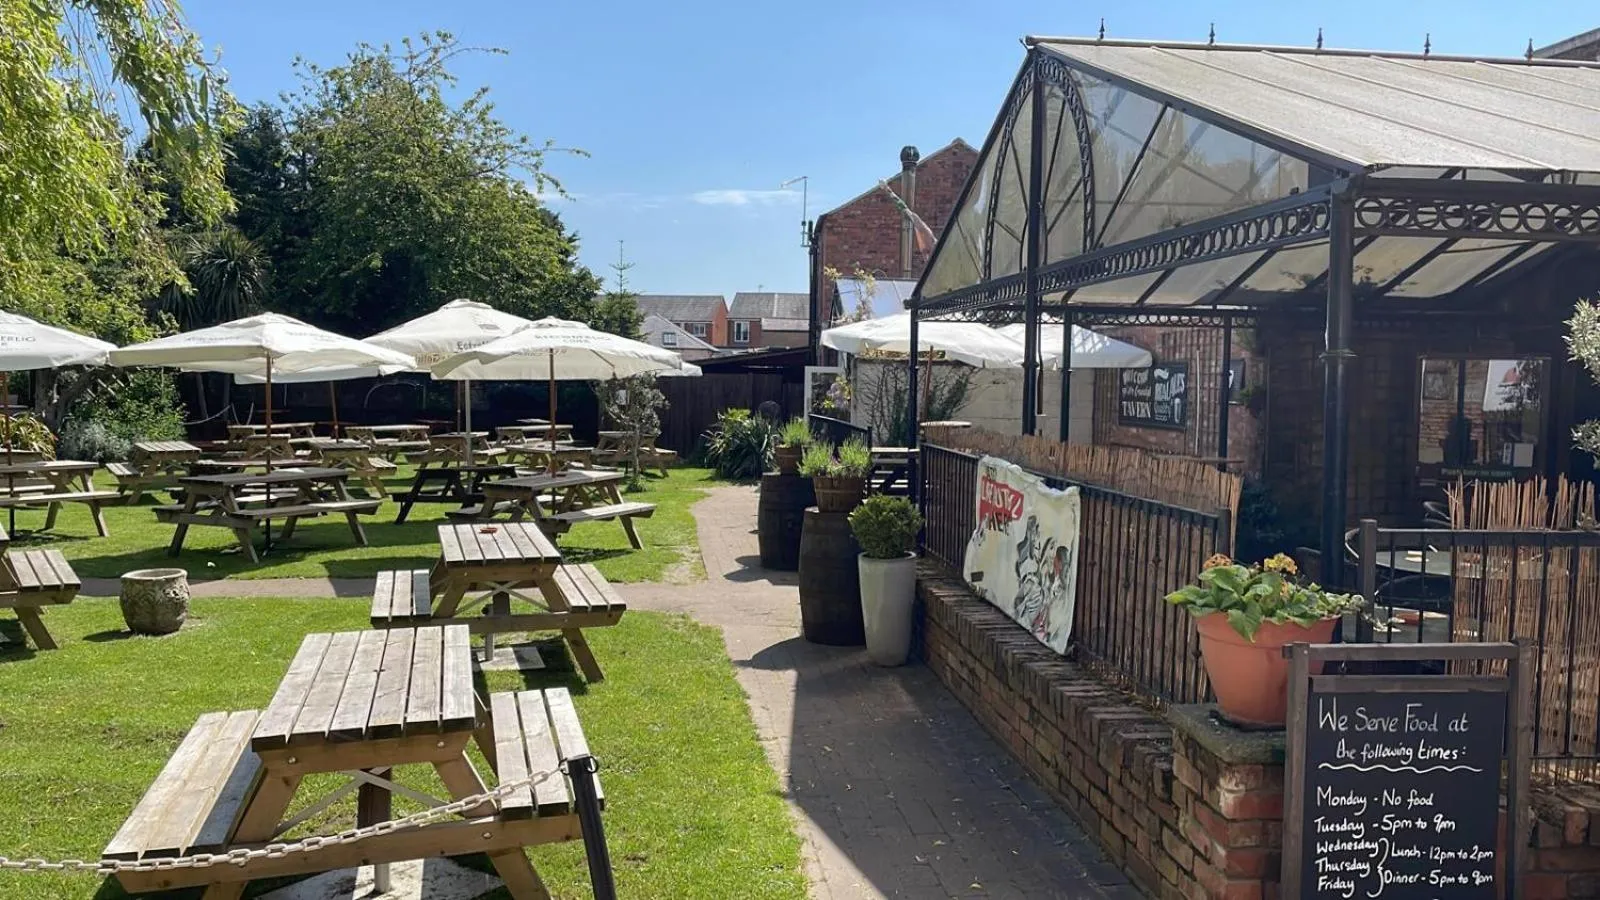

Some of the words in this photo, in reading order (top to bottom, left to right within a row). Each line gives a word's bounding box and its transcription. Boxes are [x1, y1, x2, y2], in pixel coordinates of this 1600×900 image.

[1319, 697, 1348, 732] We
[1355, 707, 1399, 732] Serve
[1405, 703, 1438, 733] Food
[1448, 713, 1469, 732] at
[1336, 738, 1356, 758] the
[1360, 743, 1413, 765] following
[1317, 786, 1367, 816] Monday
[1382, 788, 1402, 806] No
[1407, 789, 1433, 810] food
[1314, 816, 1365, 839] Tuesday
[1415, 817, 1426, 829] to
[1433, 814, 1456, 833] 9pm
[1317, 840, 1379, 857] Wednesday
[1391, 841, 1421, 857] Lunch
[1429, 845, 1456, 864] 12pm
[1457, 849, 1468, 859] to
[1469, 845, 1493, 863] 2pm
[1315, 857, 1370, 878] Thursday
[1384, 871, 1420, 883] Dinner
[1429, 871, 1456, 887] 5pm
[1457, 873, 1469, 883] to
[1471, 871, 1493, 886] 9pm
[1317, 875, 1355, 899] Friday
